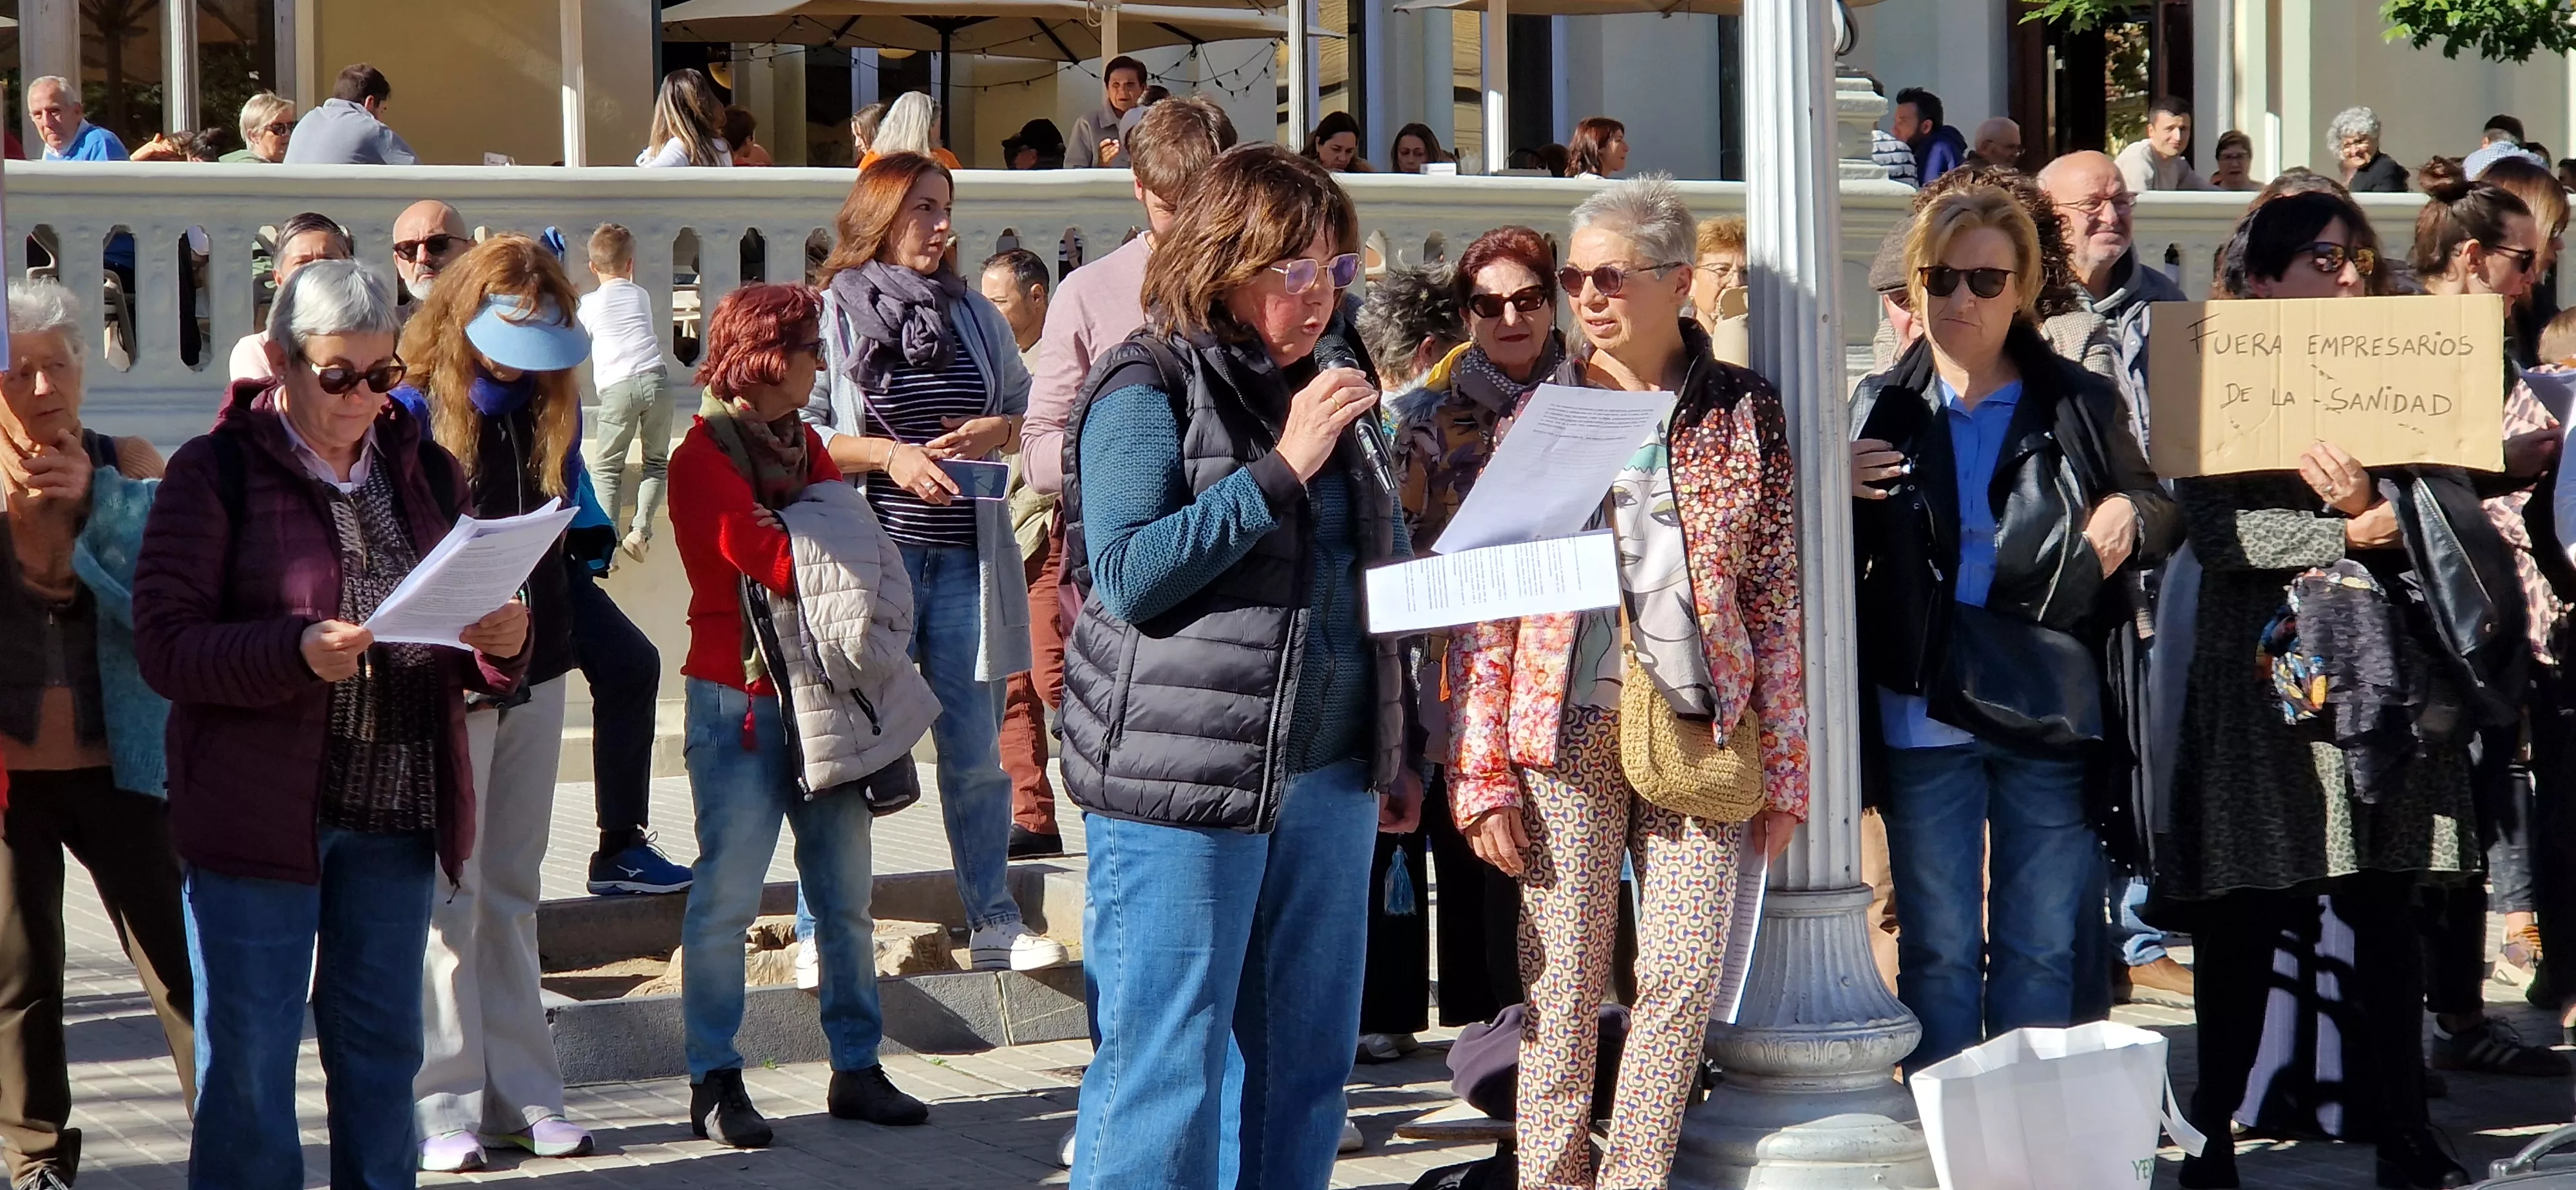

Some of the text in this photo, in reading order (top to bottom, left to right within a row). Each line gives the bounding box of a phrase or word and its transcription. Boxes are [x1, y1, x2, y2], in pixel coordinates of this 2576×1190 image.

[2186, 313, 2282, 357] FUERA
[2221, 382, 2253, 409] DE
[2271, 388, 2296, 406] LA
